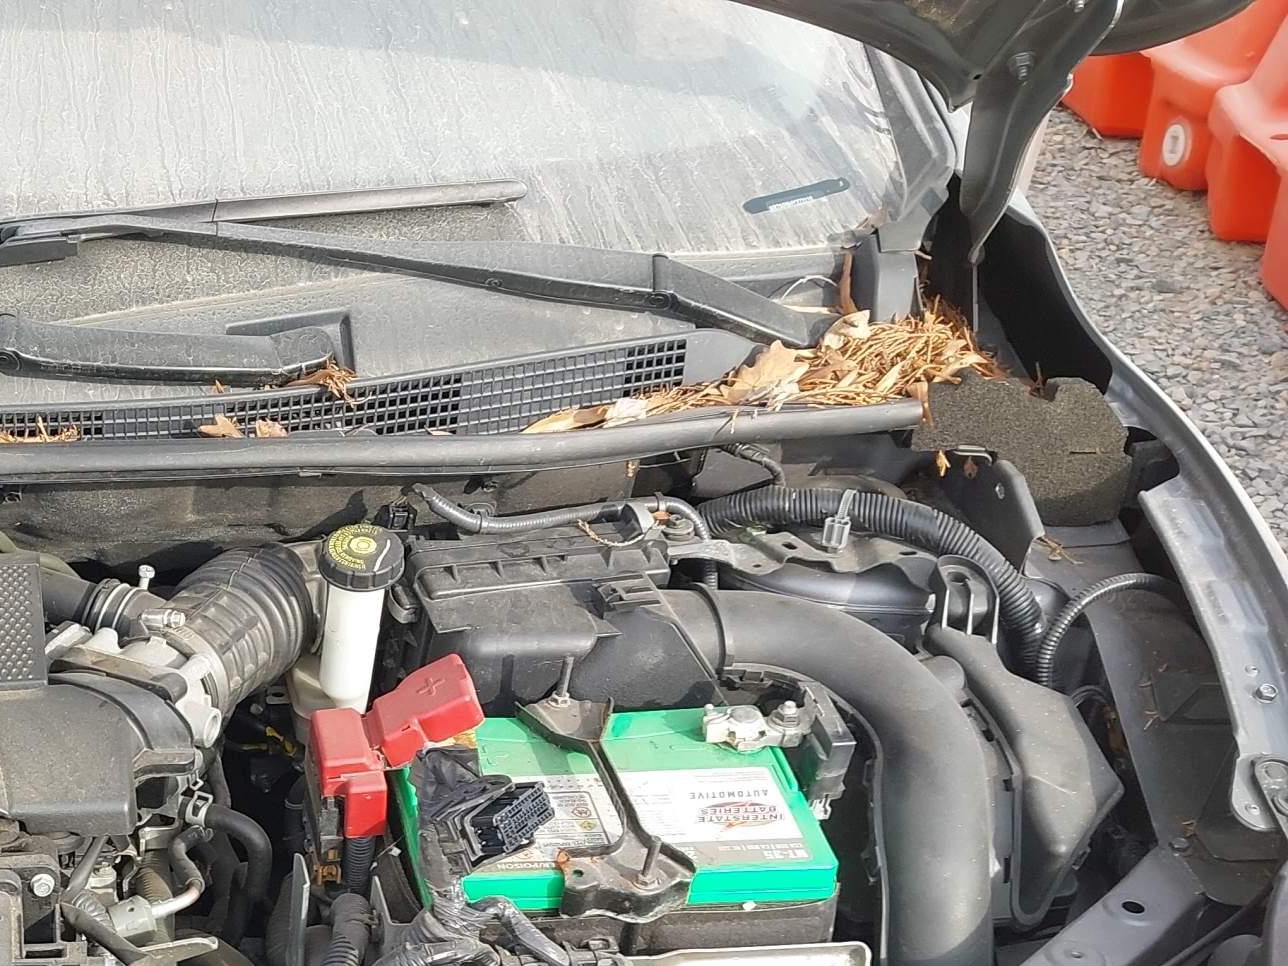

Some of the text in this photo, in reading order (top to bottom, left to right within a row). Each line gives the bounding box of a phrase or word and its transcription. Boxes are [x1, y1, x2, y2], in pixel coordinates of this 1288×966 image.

[689, 789, 769, 800] AUTOMOTIVE
[700, 805, 777, 815] BATTERIES
[697, 813, 784, 823] INTERSTATE
